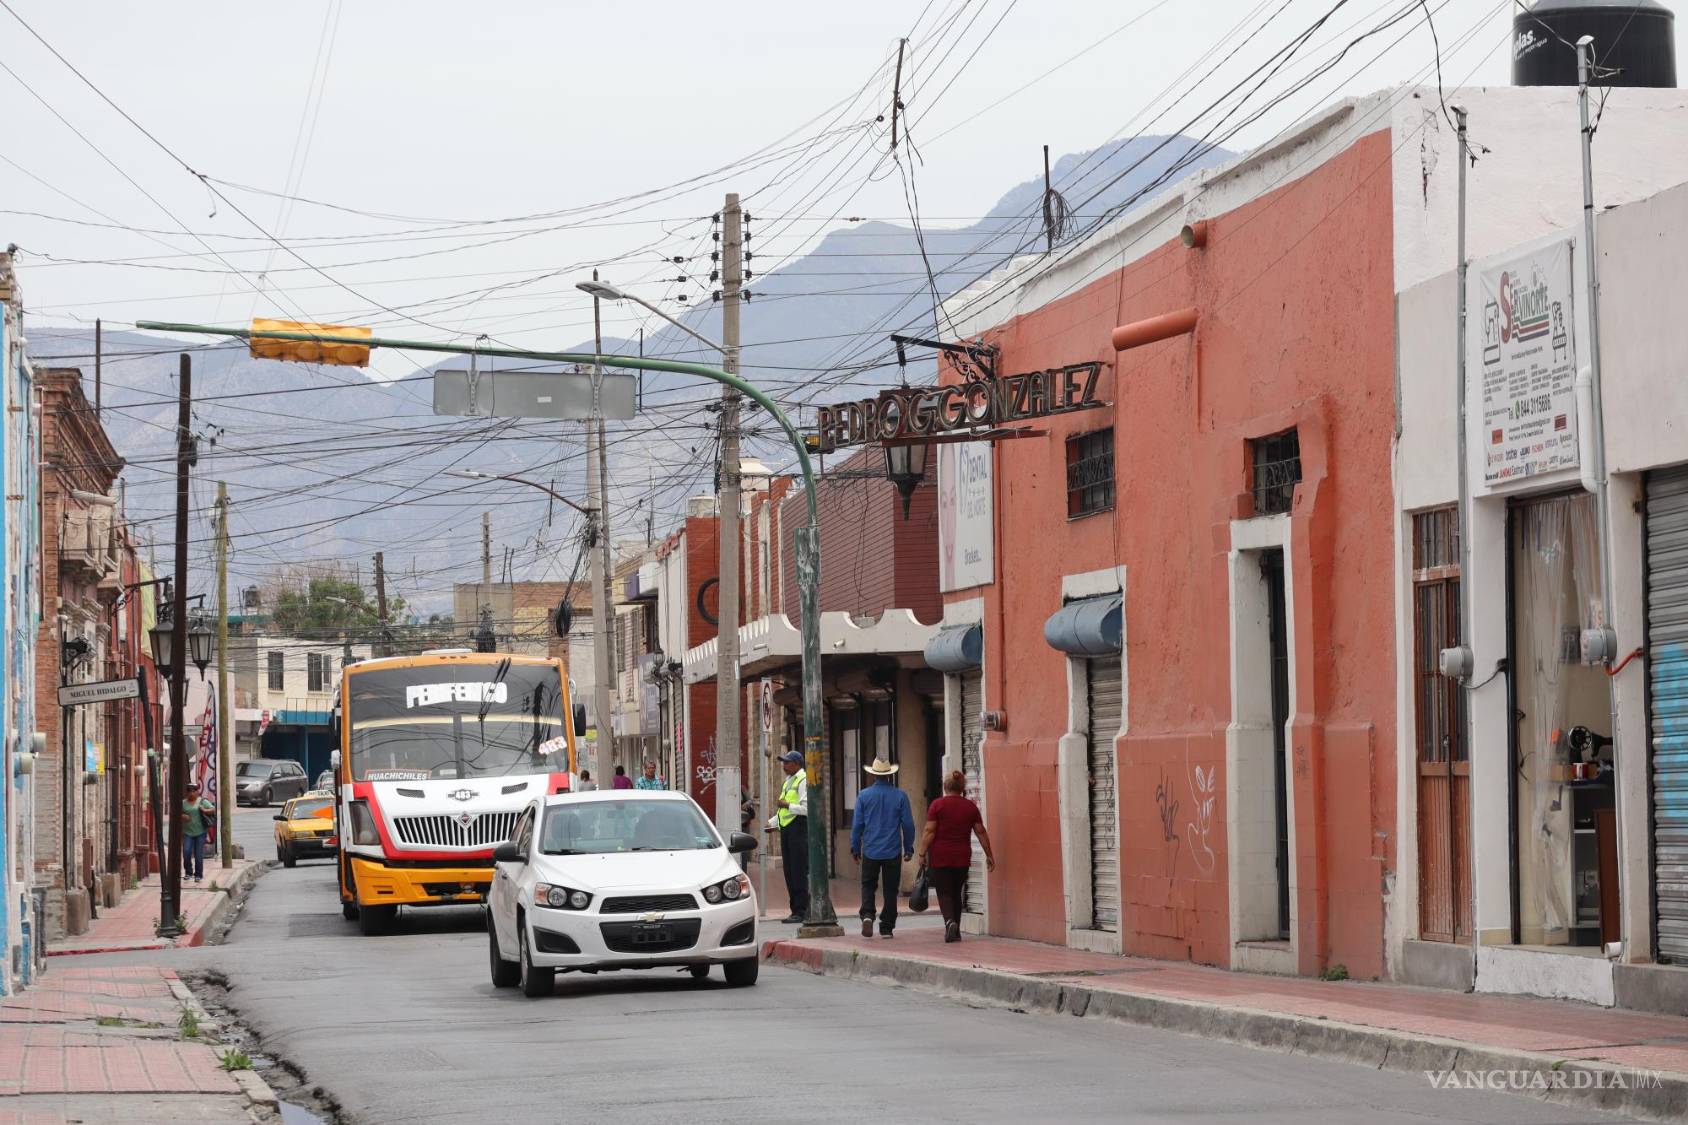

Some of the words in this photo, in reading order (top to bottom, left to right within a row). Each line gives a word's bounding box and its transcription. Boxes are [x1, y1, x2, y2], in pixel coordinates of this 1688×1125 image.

[817, 393, 901, 449] PEDRO
[936, 362, 1101, 431] GONZALEZ
[70, 690, 95, 698] MIGUEL
[97, 686, 127, 695] HIDALGO
[367, 772, 428, 781] HUACHICHILES
[455, 790, 471, 799] 483
